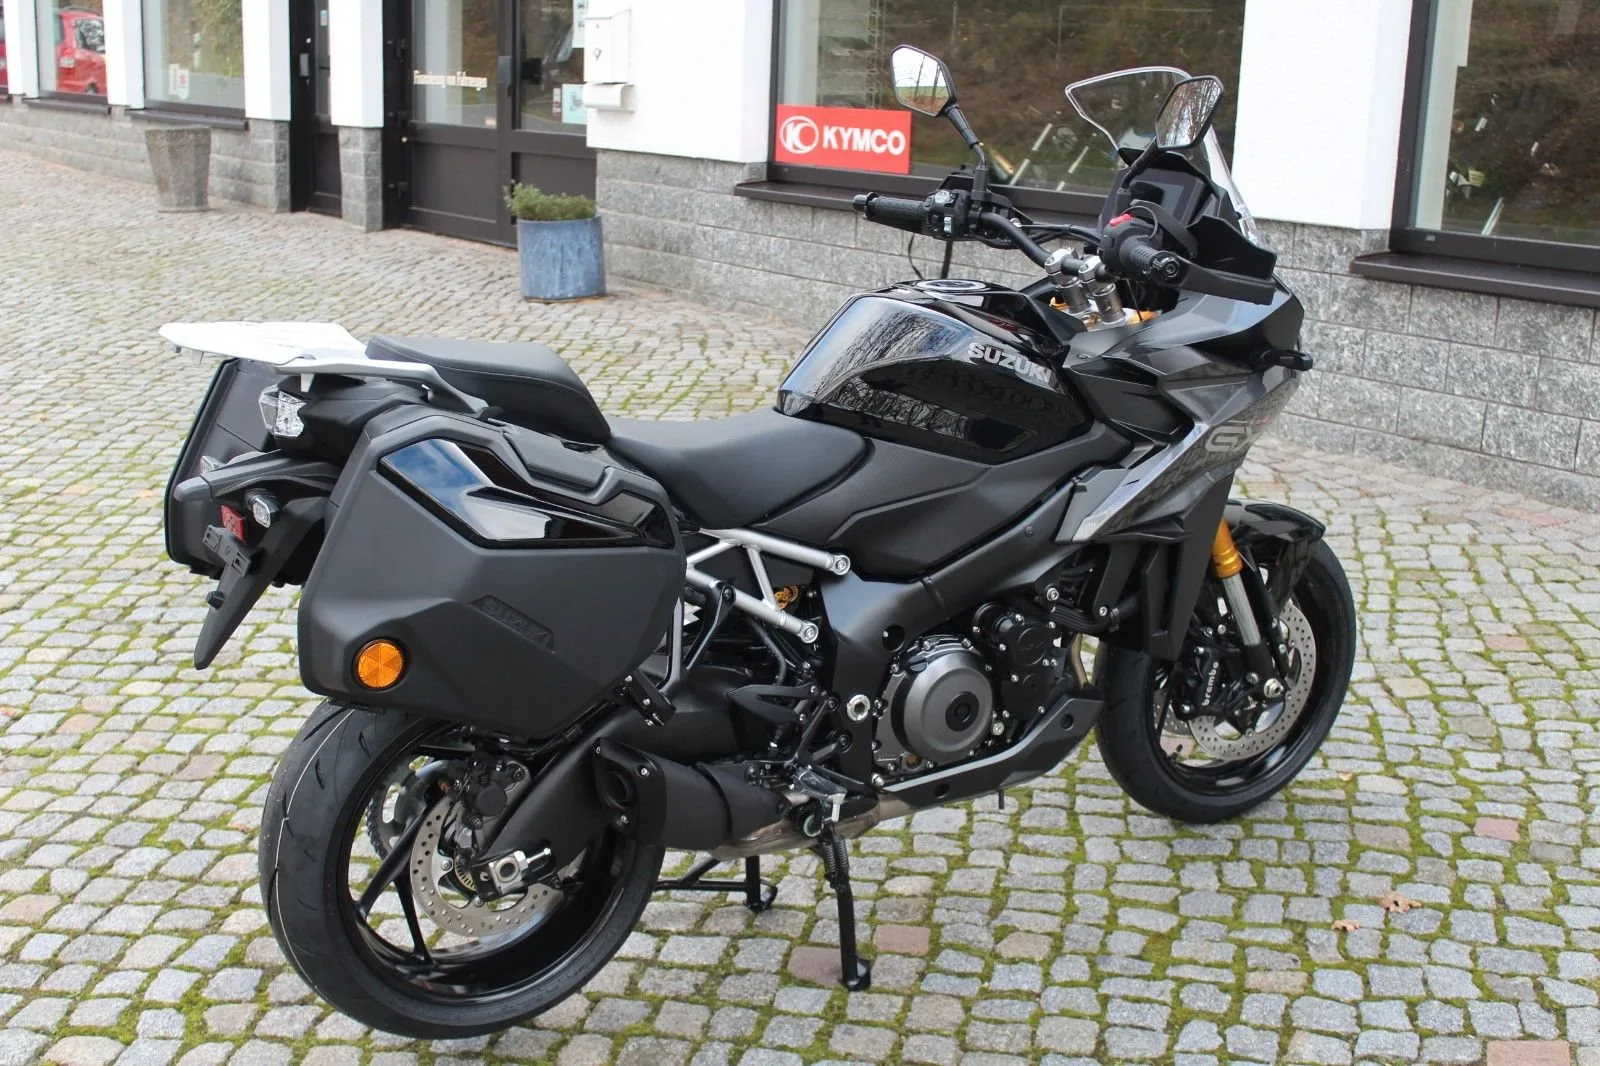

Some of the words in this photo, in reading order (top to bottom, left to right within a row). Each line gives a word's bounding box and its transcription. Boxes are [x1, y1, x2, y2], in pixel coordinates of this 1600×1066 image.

[822, 125, 906, 155] KYMCO
[967, 342, 1052, 384] SUZUKI
[1201, 661, 1219, 706] brembo
